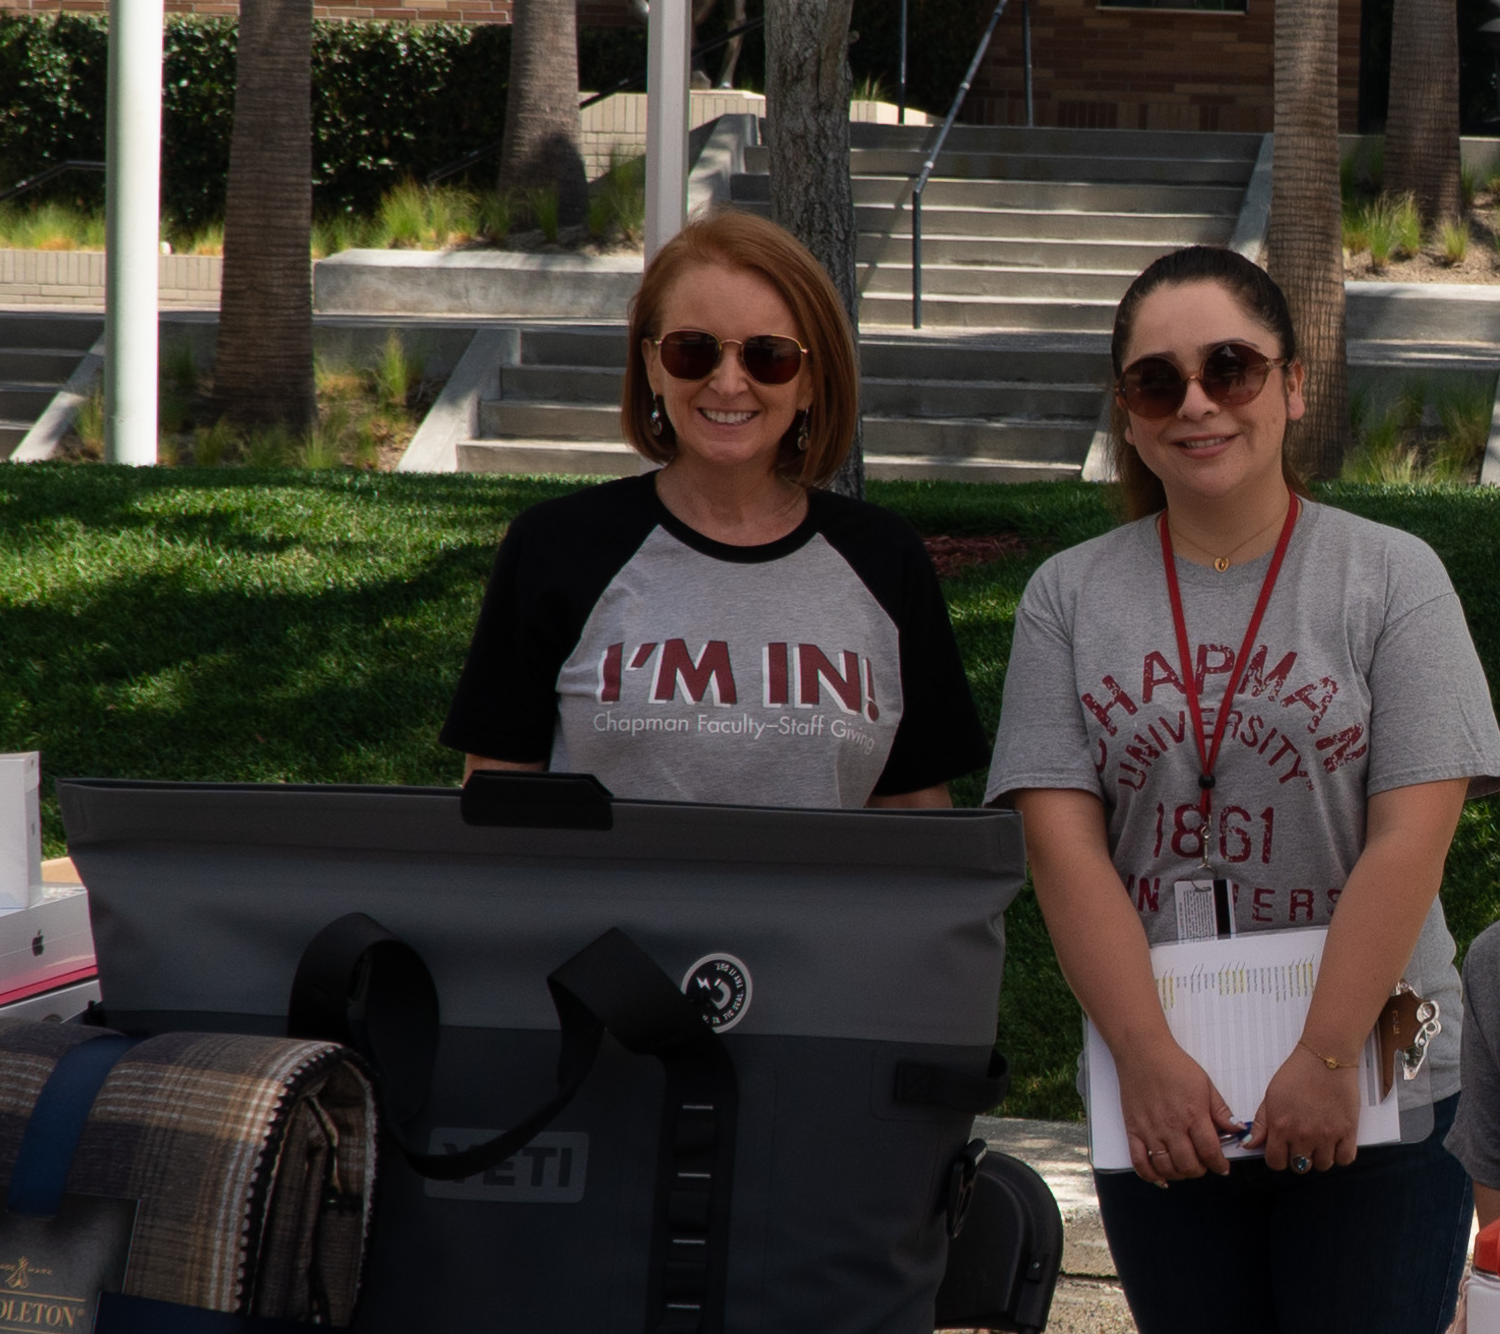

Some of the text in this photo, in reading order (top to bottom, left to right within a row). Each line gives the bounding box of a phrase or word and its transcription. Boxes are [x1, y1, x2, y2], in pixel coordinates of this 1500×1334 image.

[762, 642, 879, 723] IN!
[593, 710, 876, 756] Chapman Giving
[1153, 803, 1275, 865] 1861
